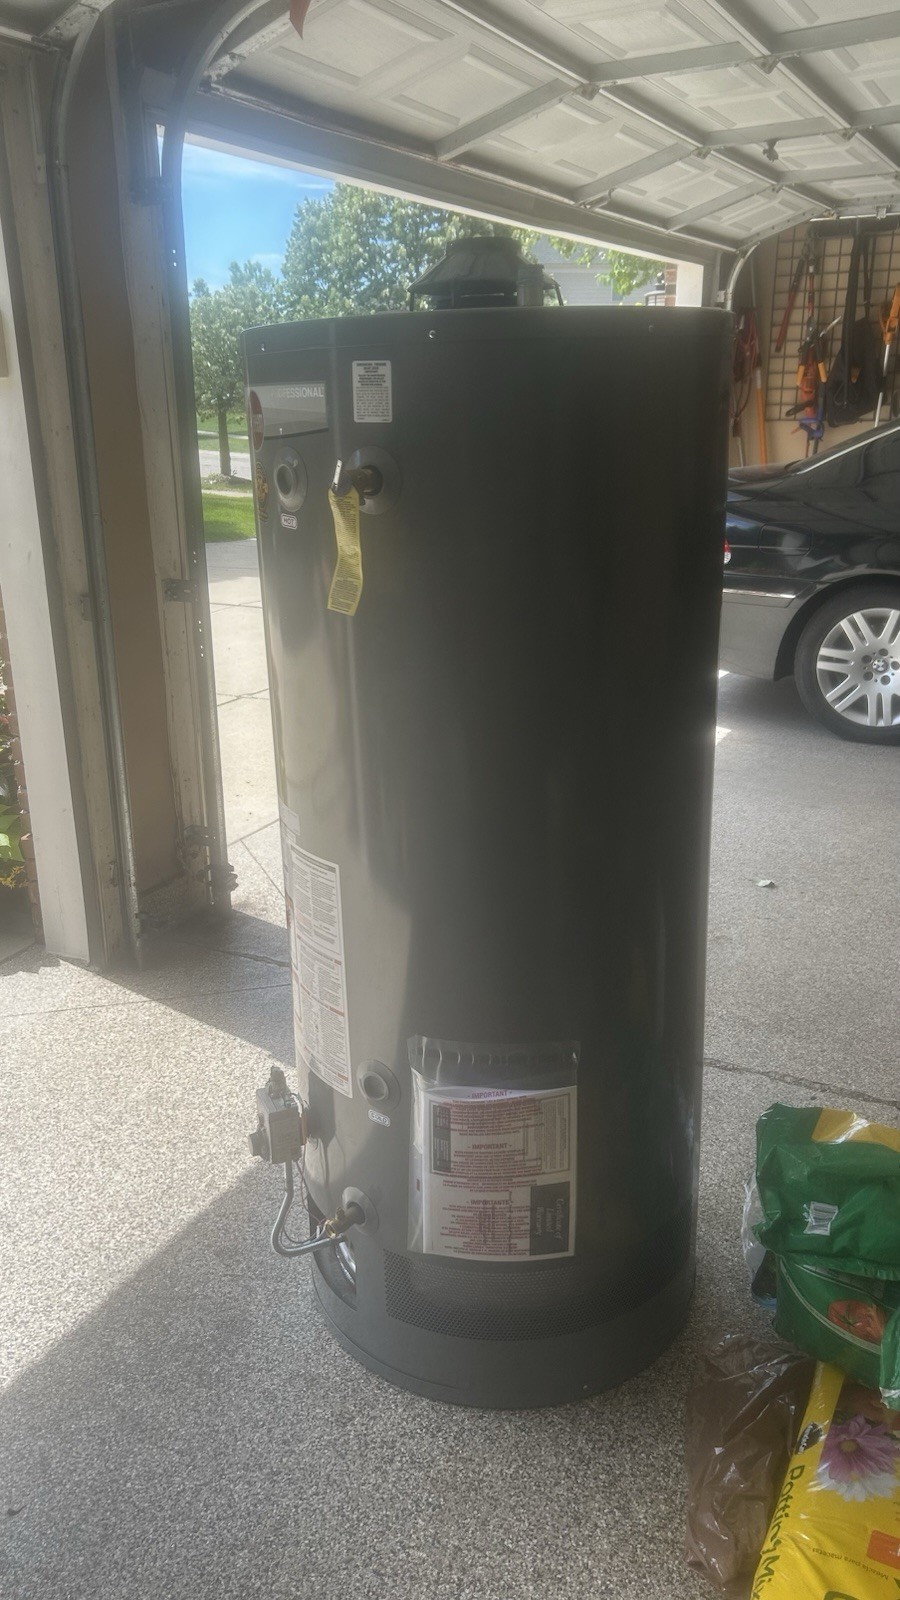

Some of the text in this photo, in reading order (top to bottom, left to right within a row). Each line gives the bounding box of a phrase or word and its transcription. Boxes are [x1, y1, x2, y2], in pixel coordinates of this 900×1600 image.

[271, 386, 324, 399] OFESSIONAL
[471, 1090, 508, 1099] IMPORTANT
[762, 1465, 806, 1555] Potting
[844, 1555, 861, 1566] para
